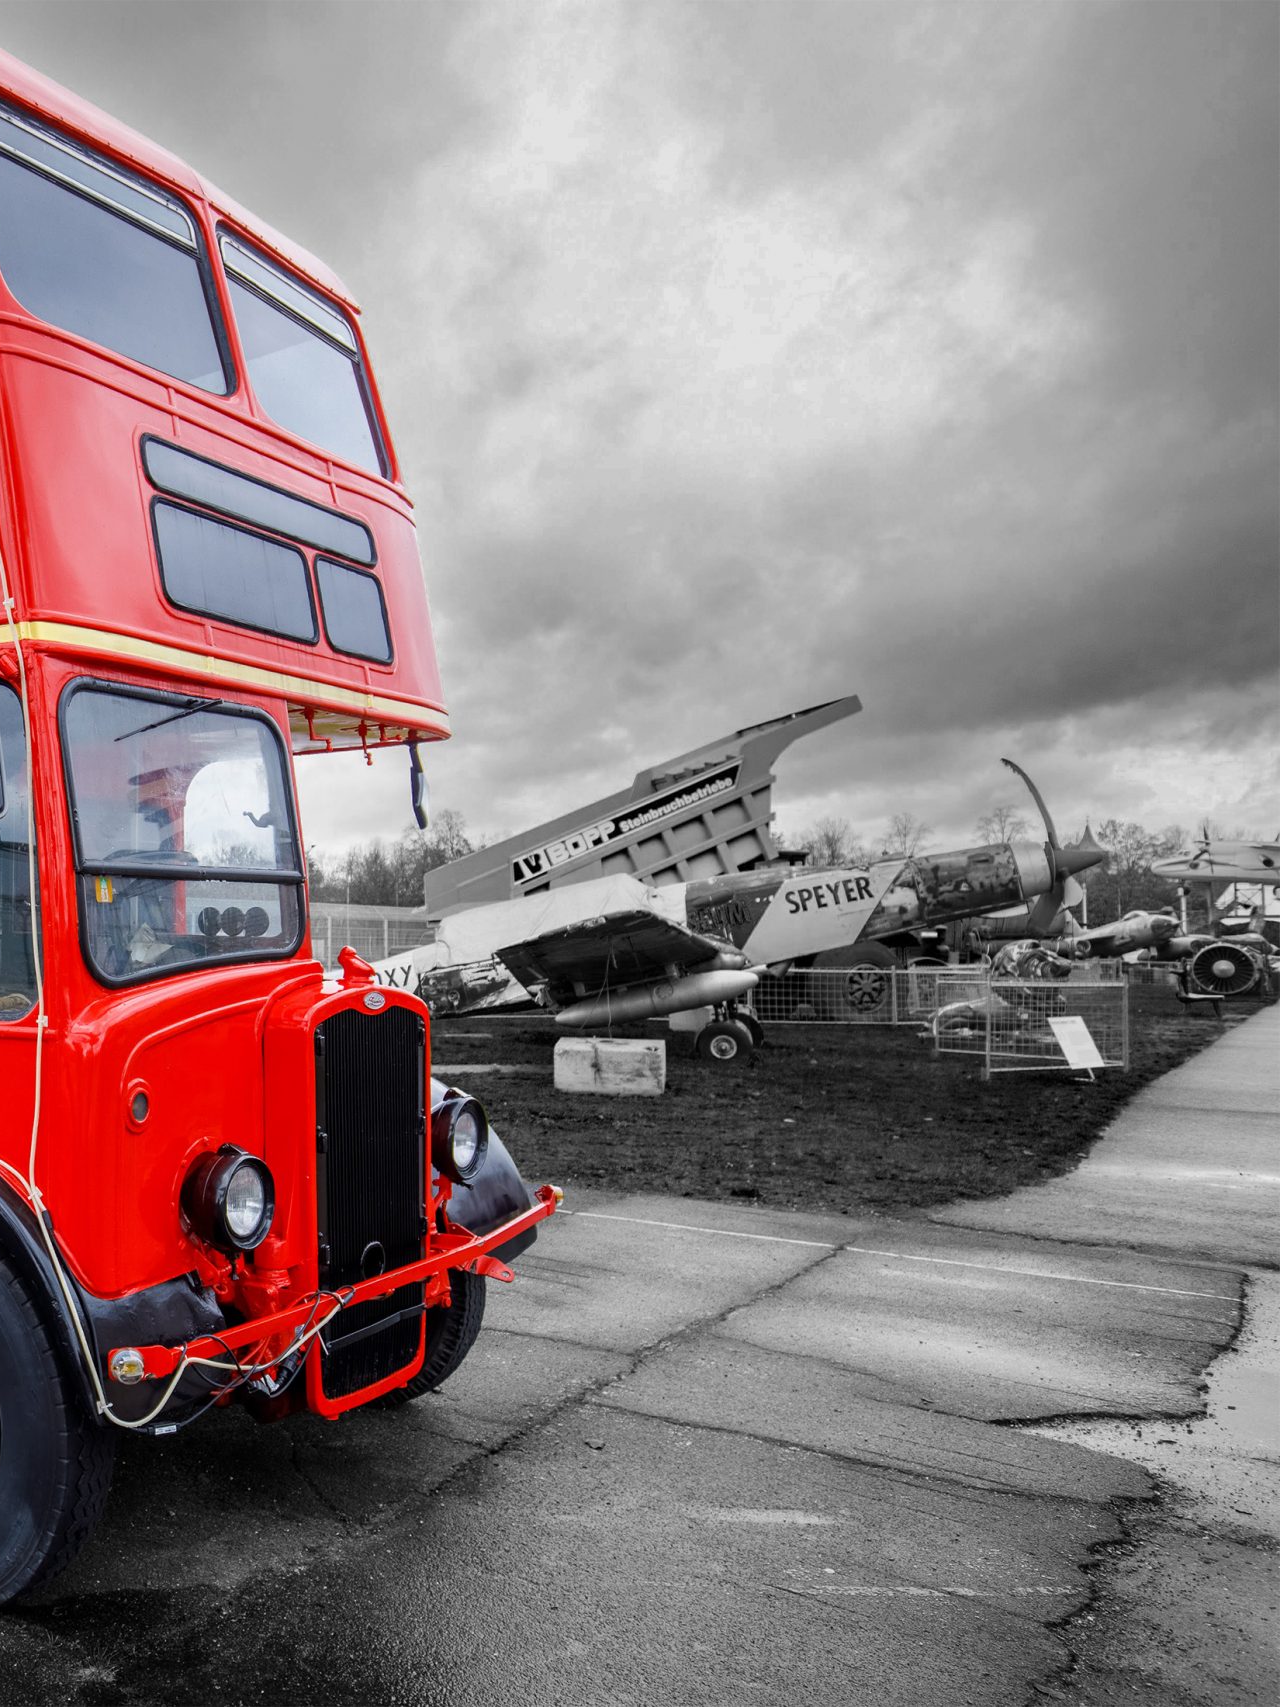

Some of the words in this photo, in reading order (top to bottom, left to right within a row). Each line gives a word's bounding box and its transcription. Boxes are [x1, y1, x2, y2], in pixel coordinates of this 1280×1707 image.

[546, 819, 616, 866] BOPP
[618, 777, 733, 833] Steinbruchbetriebe
[785, 876, 875, 914] SPEYER
